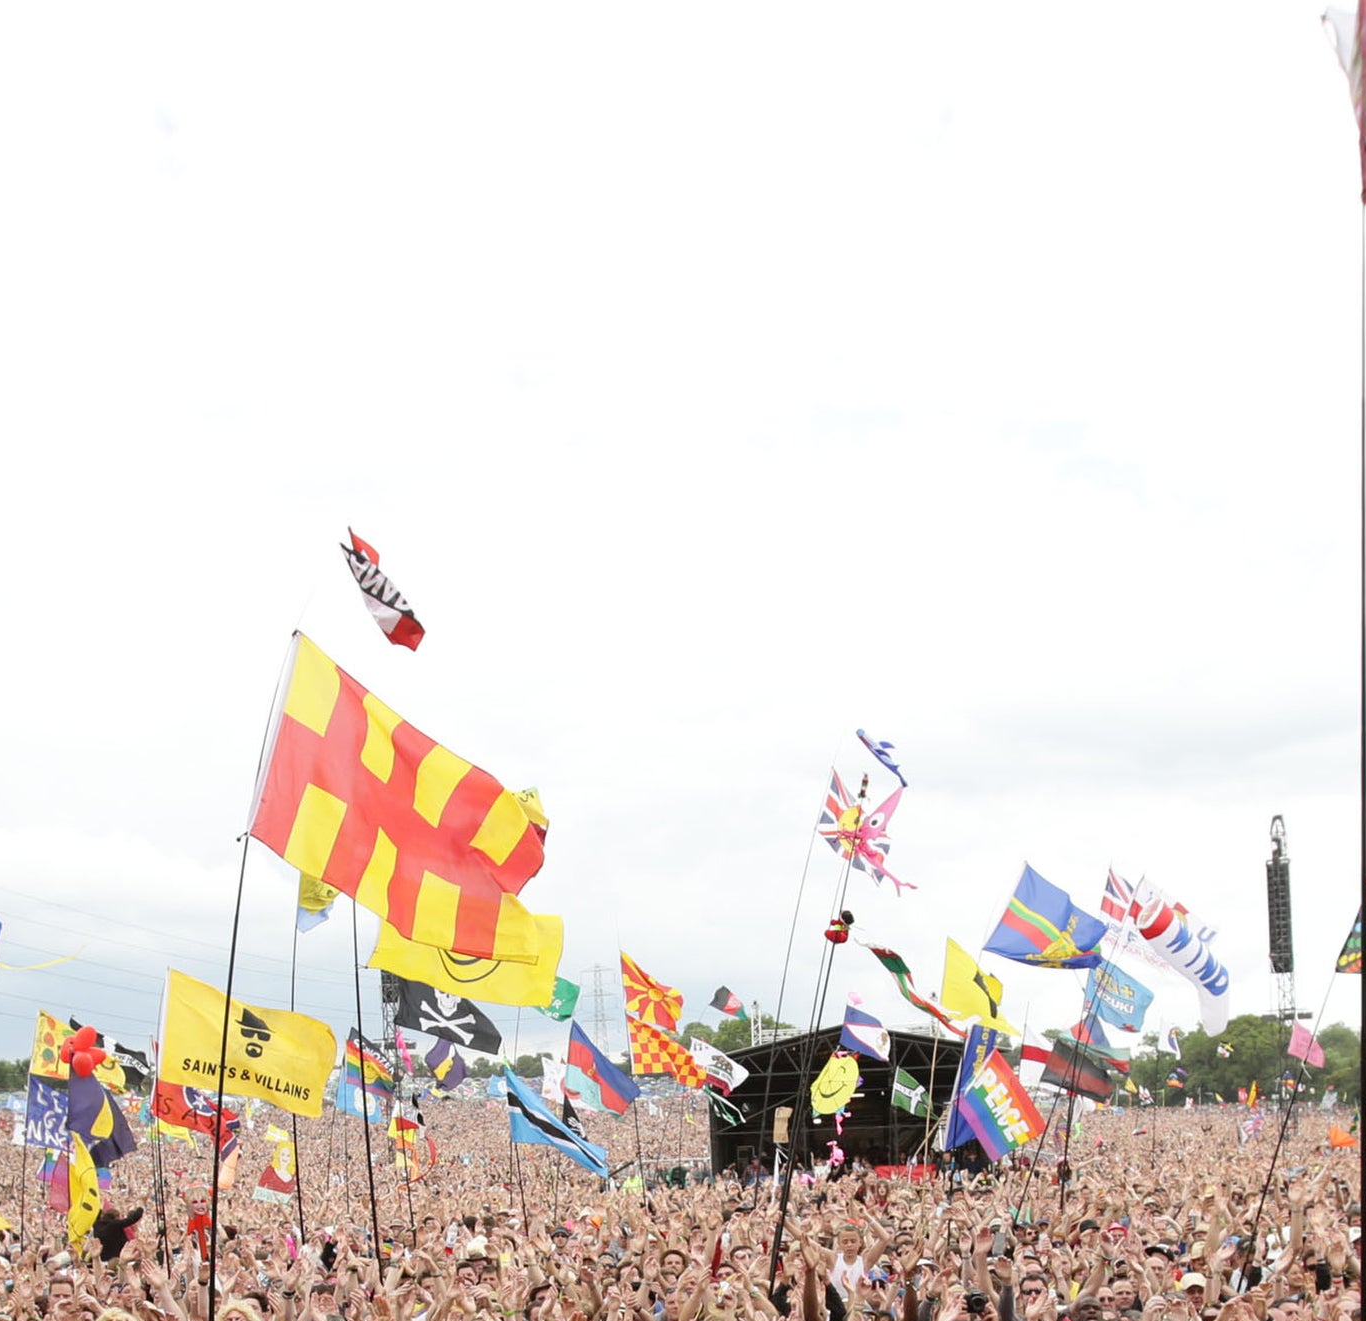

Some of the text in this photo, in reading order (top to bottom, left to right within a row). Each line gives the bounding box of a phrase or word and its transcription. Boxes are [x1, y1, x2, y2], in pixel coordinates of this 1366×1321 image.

[1166, 919, 1229, 997] WIND
[240, 1069, 251, 1081] &
[254, 1072, 311, 1101] VILLAINS
[974, 1067, 1030, 1143] PEACE
